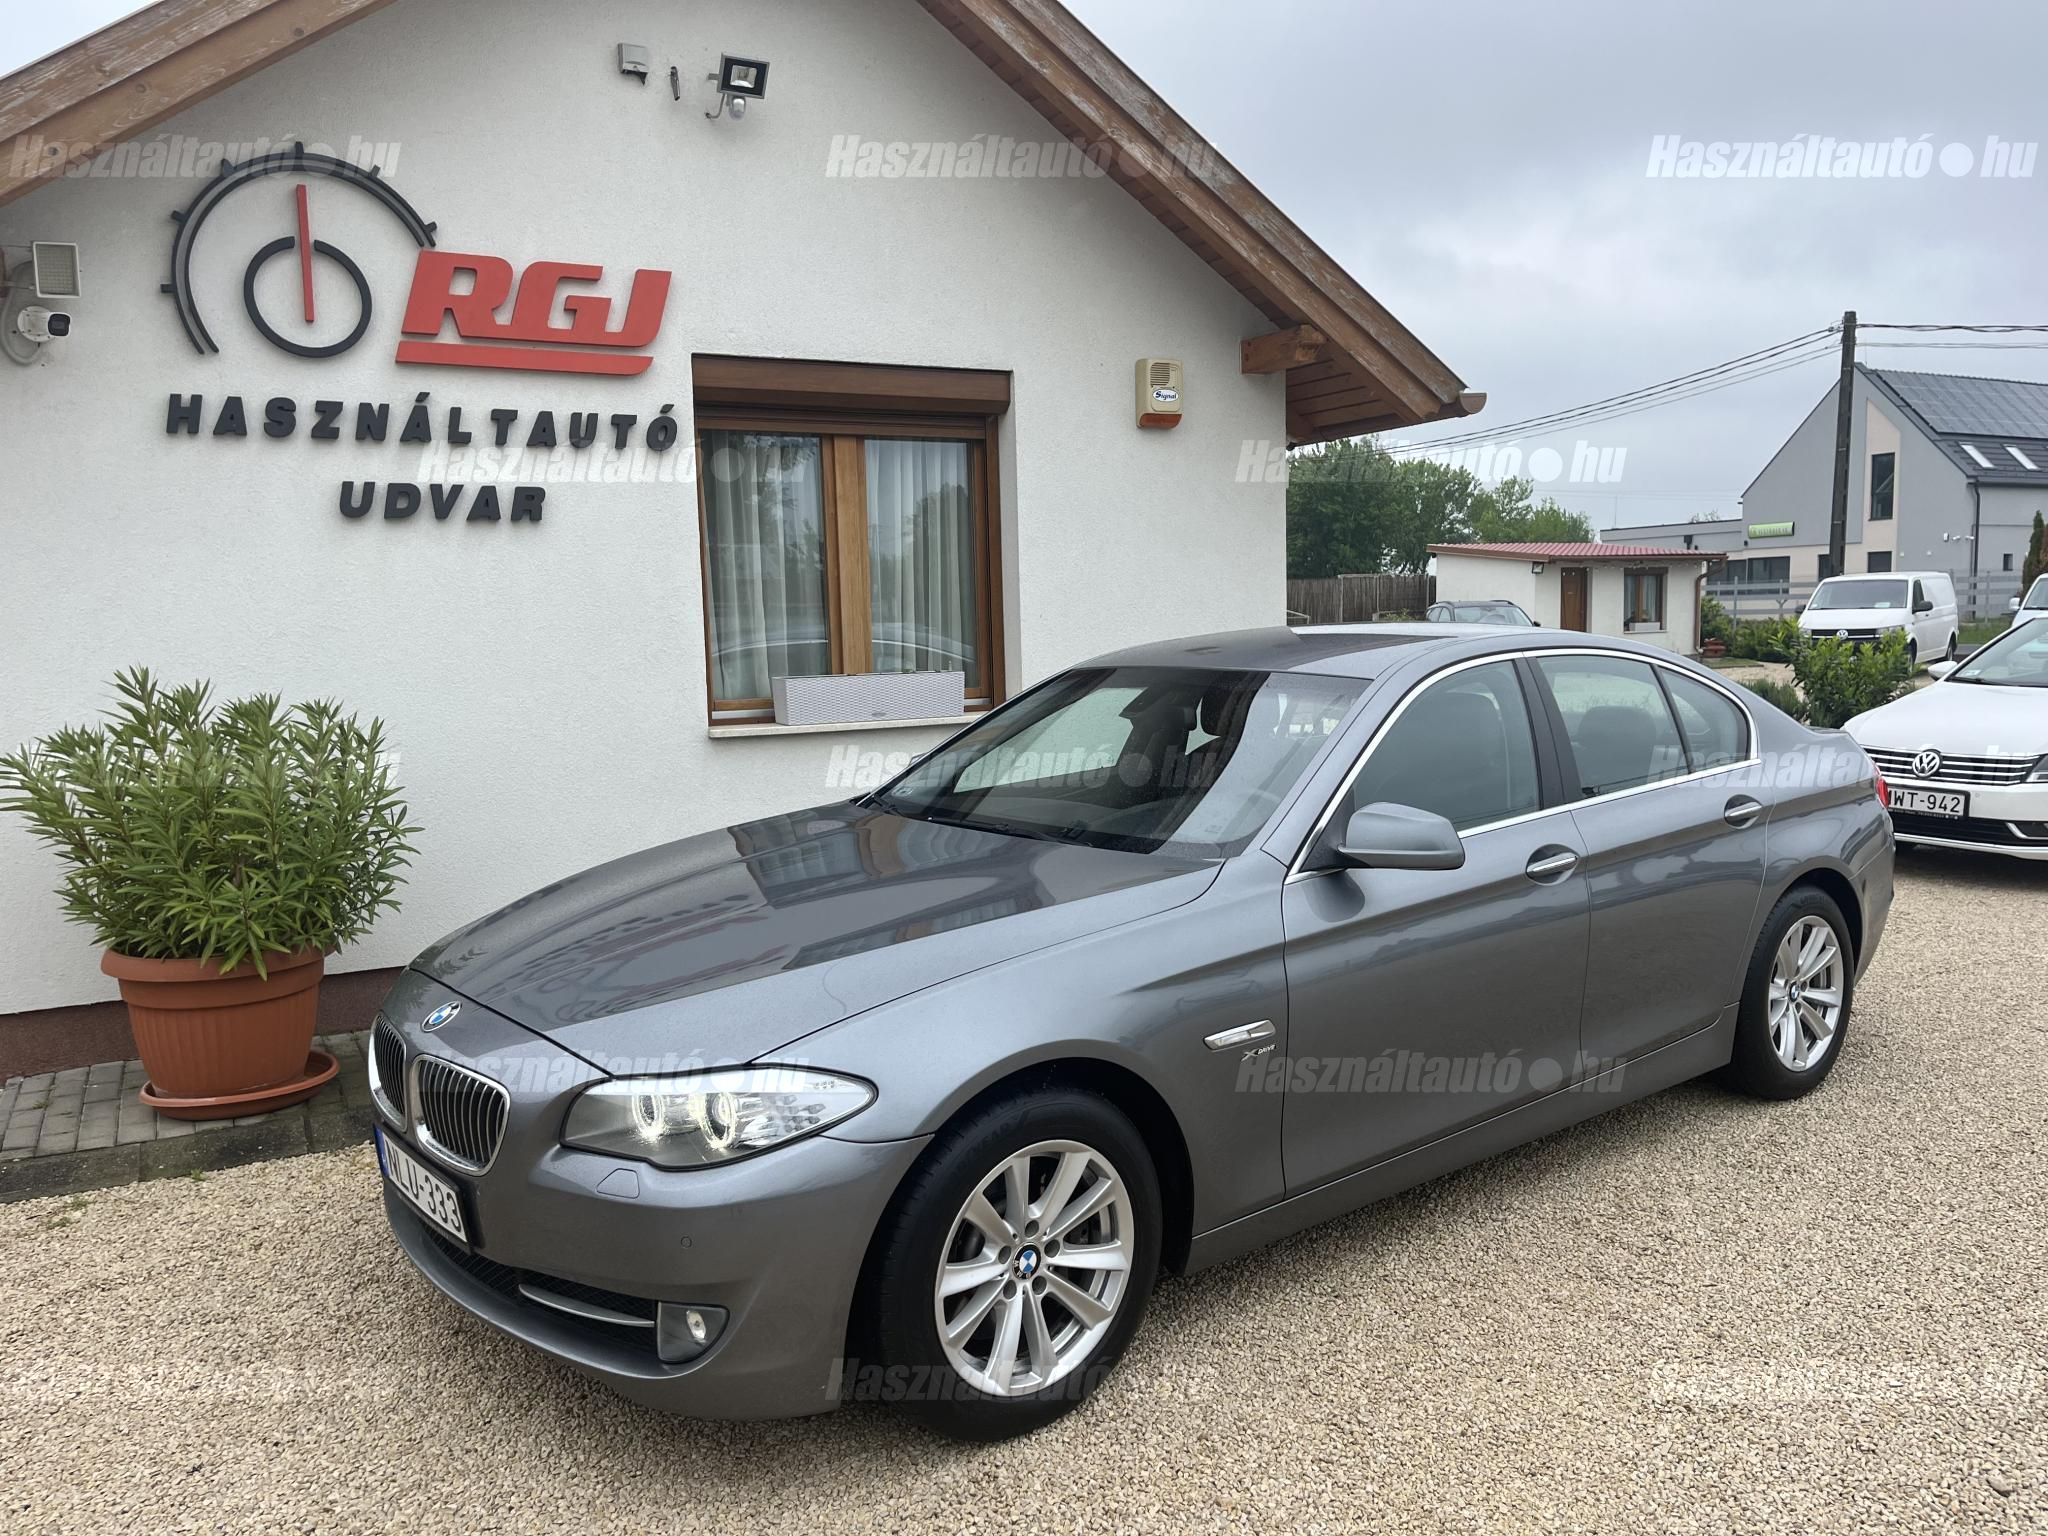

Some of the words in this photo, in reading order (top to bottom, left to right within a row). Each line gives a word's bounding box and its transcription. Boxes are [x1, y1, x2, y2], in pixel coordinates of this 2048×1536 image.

[401, 250, 672, 347] RGJ
[166, 391, 679, 451] HASZNÁLTAUTÓ
[339, 481, 547, 522] UDVAR
[385, 1139, 462, 1233] NLU-333
